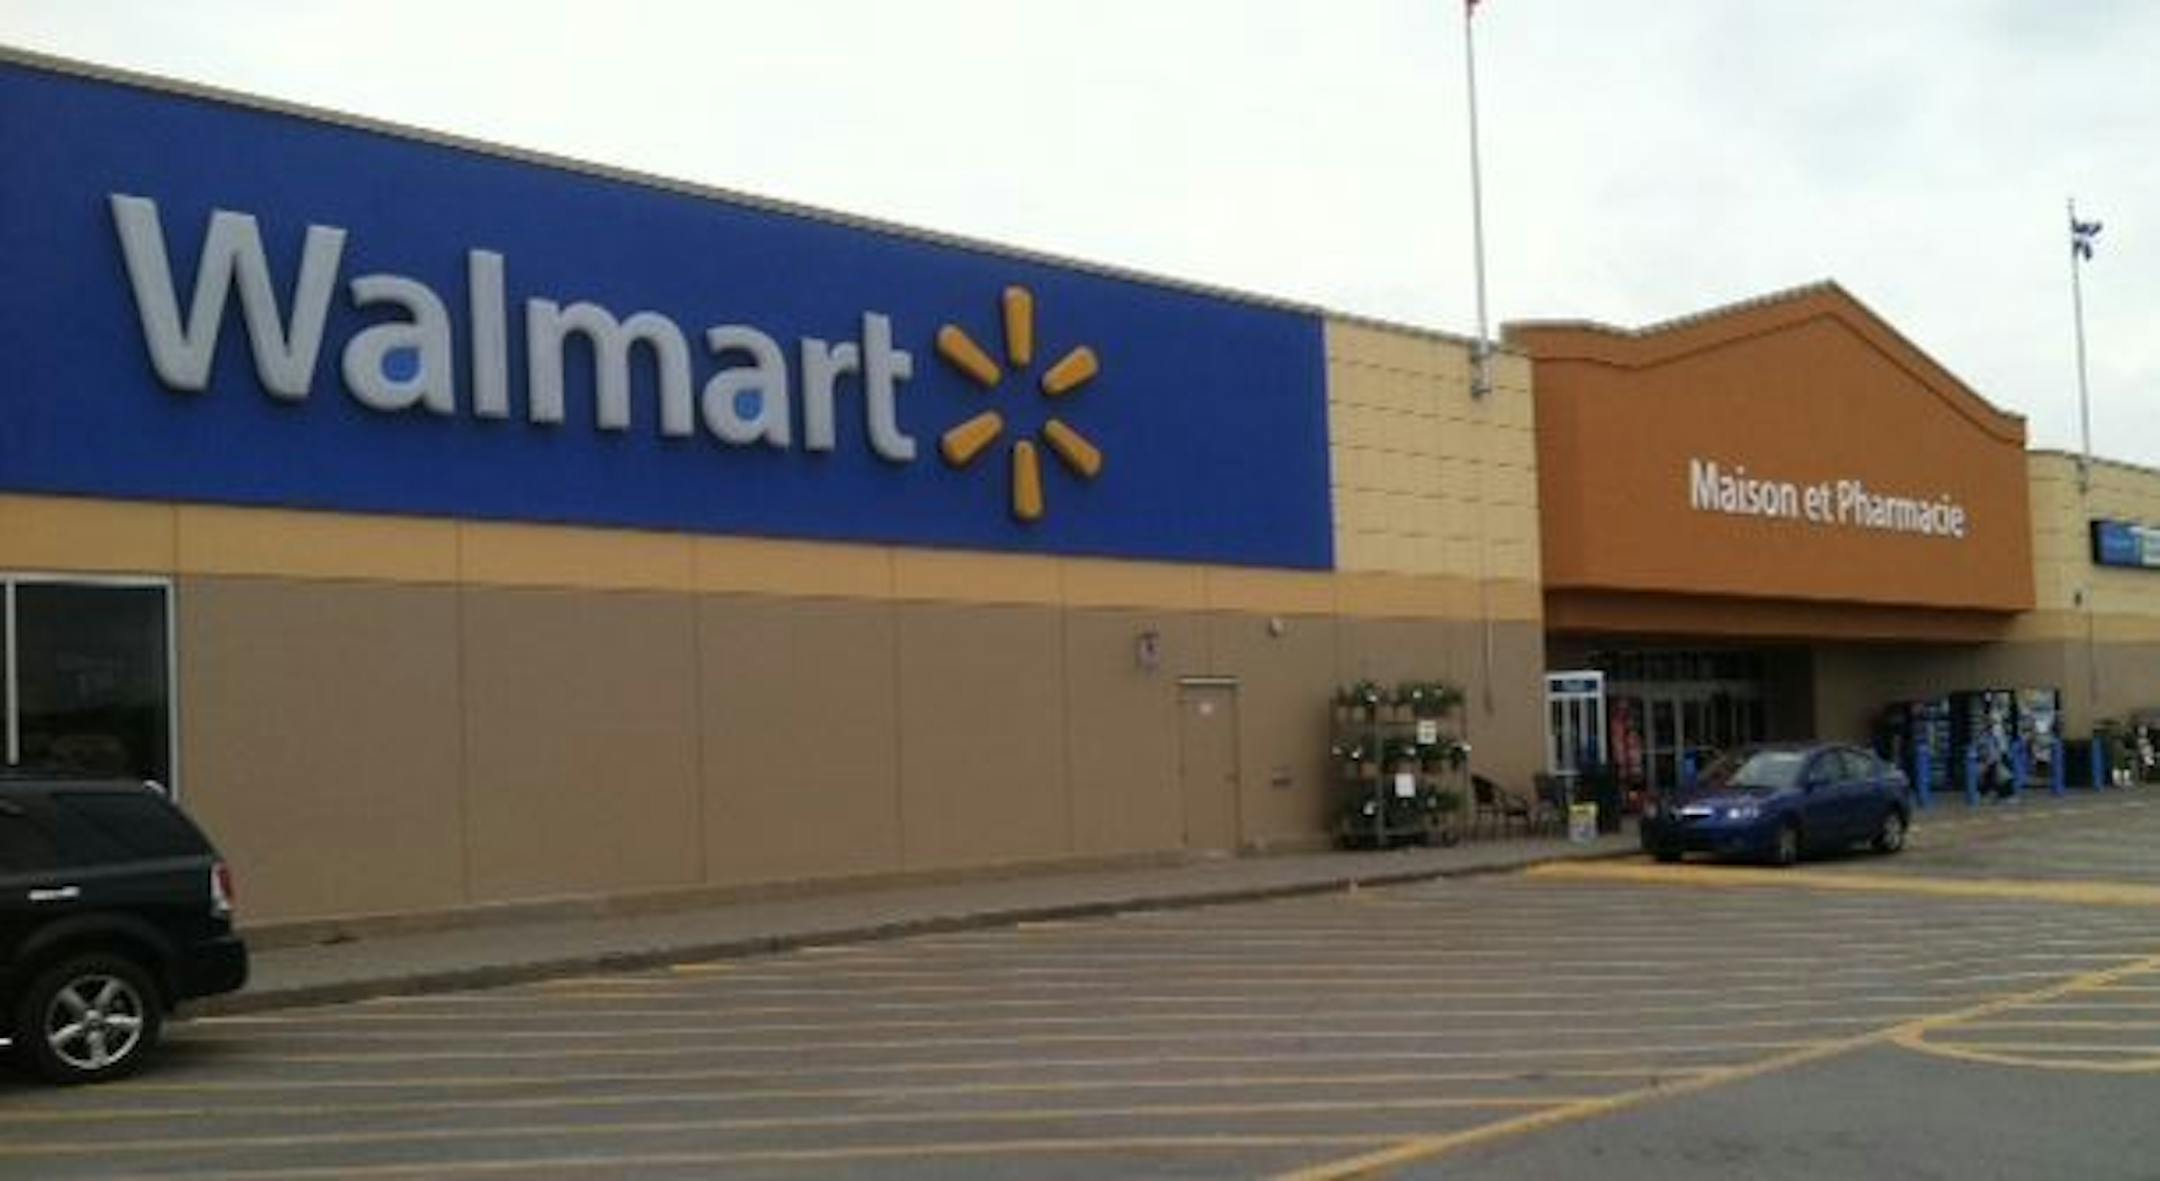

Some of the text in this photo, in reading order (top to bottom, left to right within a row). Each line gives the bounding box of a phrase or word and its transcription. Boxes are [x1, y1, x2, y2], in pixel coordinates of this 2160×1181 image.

[109, 193, 917, 463] Walmart
[1690, 458, 1965, 538] Maison et Pharmacie
